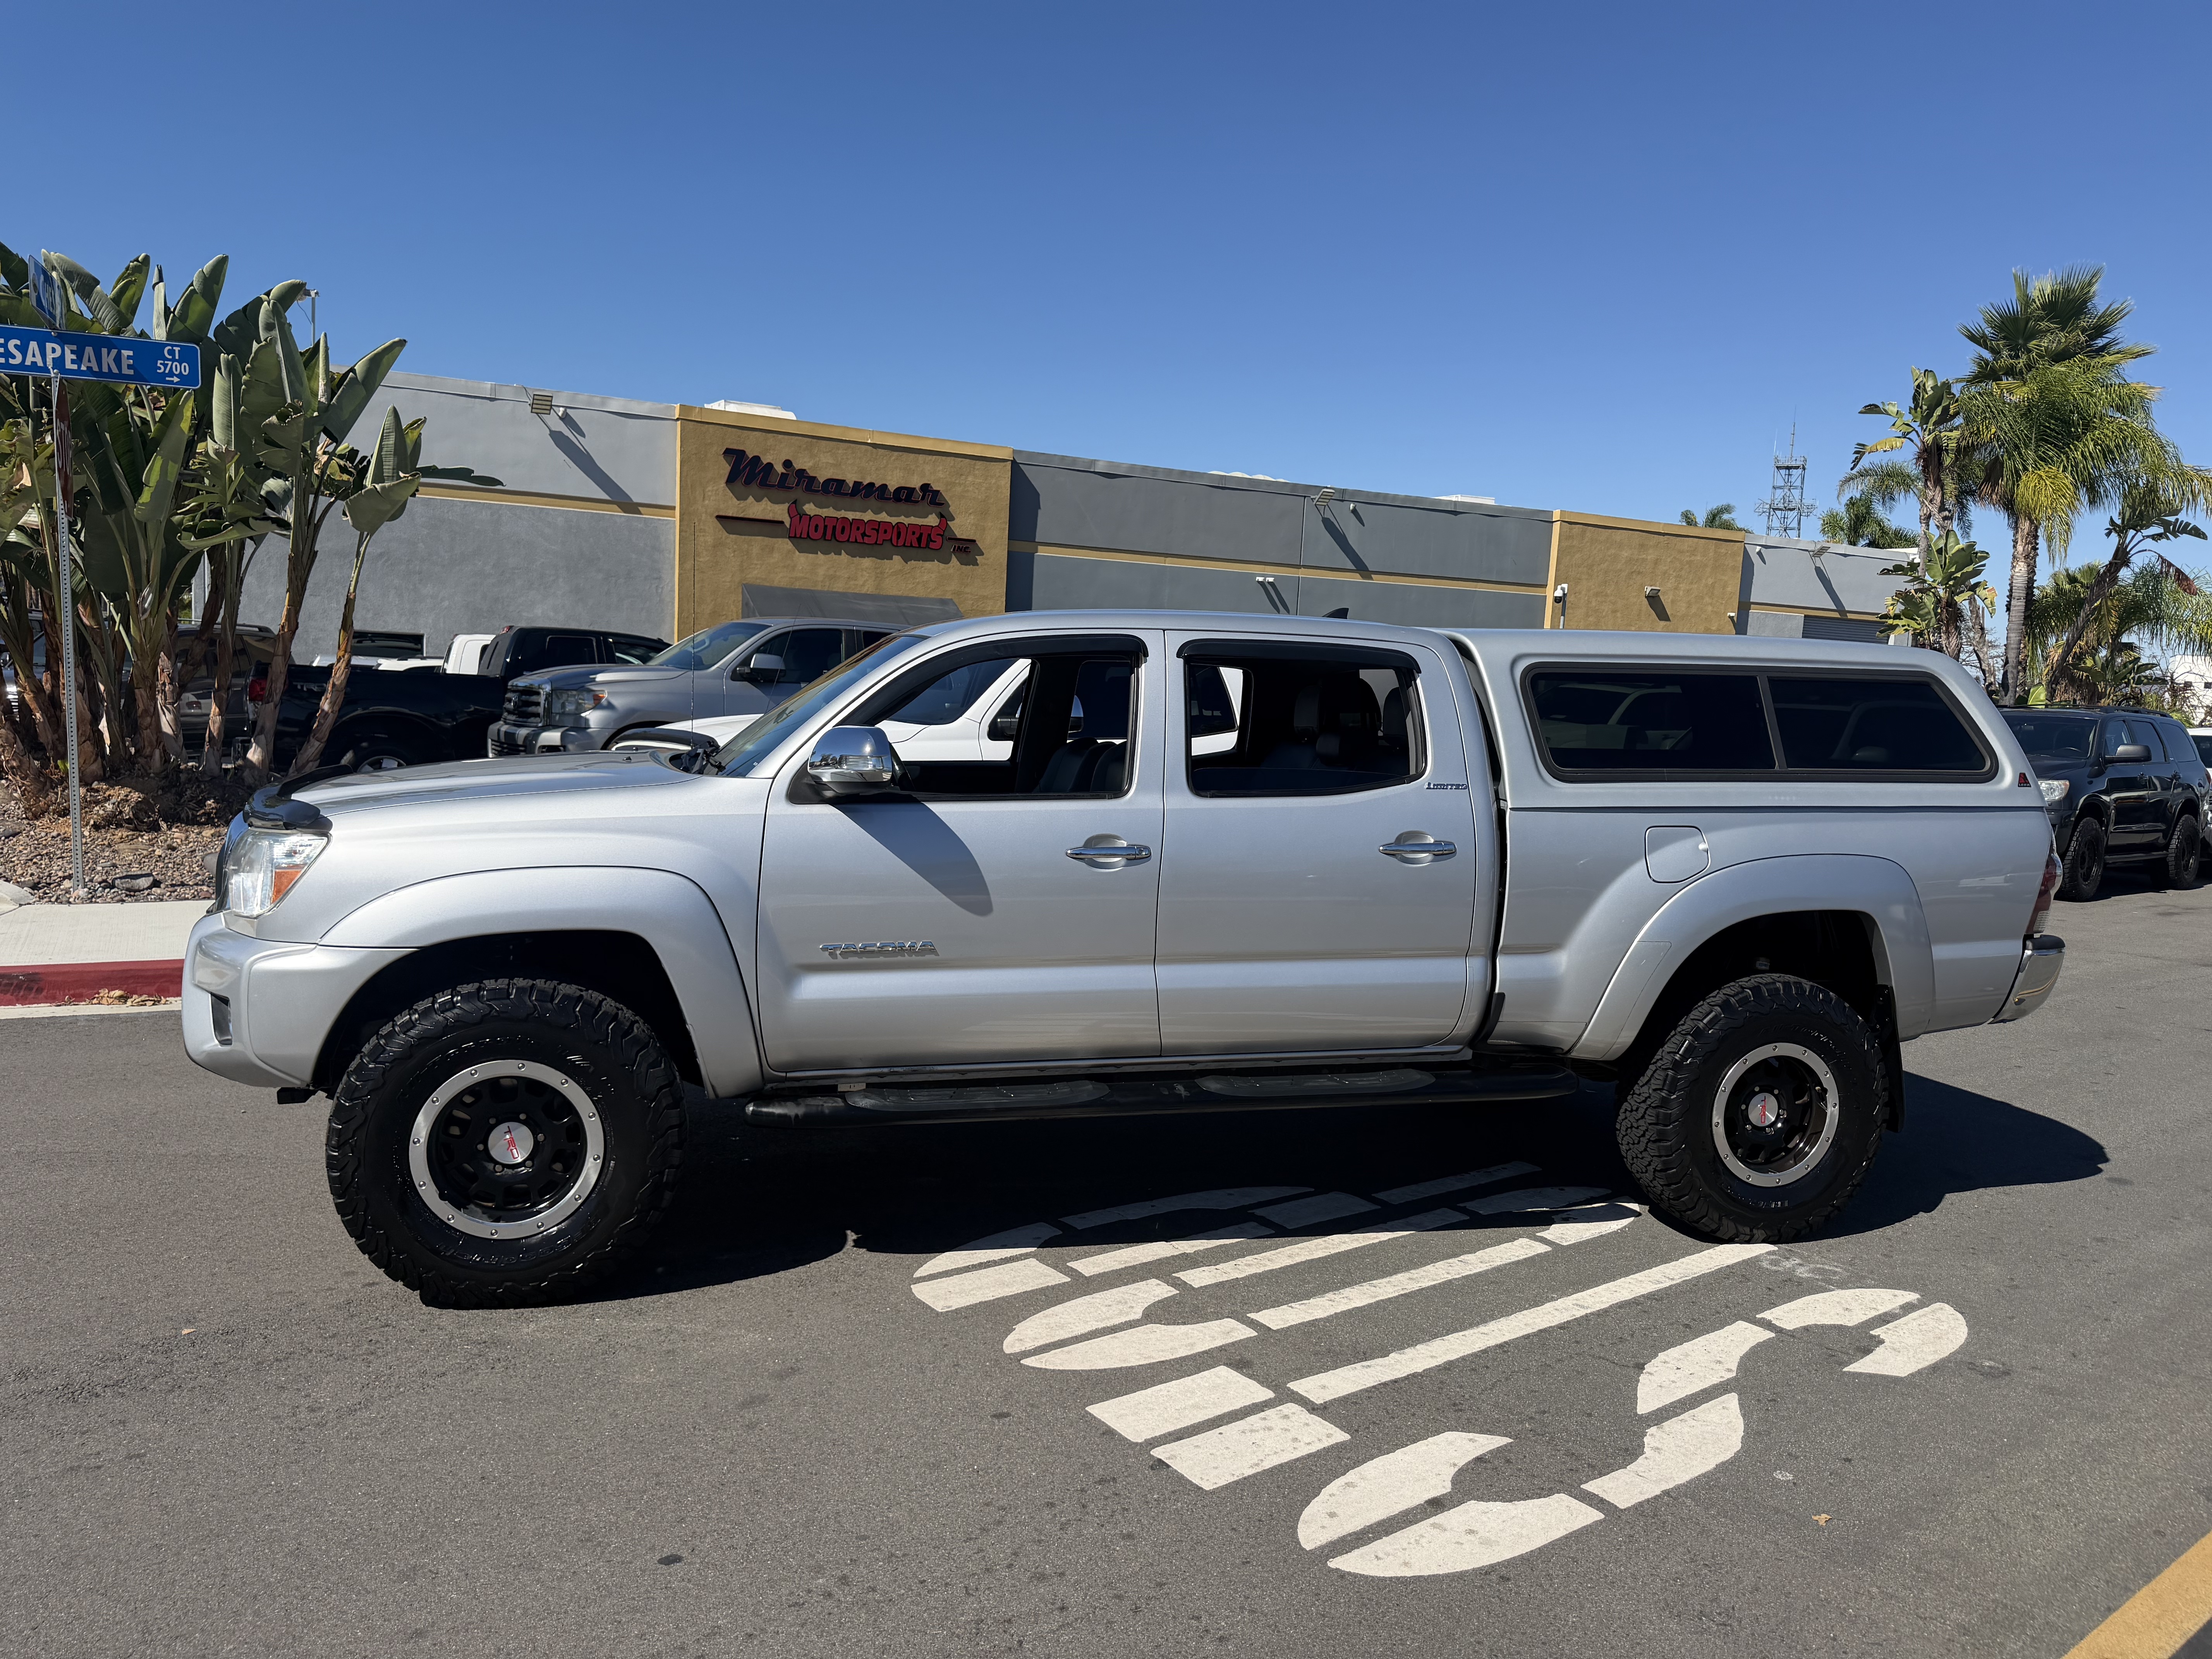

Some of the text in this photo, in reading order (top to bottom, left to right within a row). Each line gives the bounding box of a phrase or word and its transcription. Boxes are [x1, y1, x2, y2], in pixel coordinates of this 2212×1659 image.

[164, 346, 180, 359] CT
[157, 360, 189, 375] 5700
[722, 448, 945, 507] Miramar
[788, 513, 945, 550] MOTORSPORTS
[951, 544, 971, 553] INC.
[819, 941, 936, 955] TACOMA
[503, 1125, 520, 1160] TRD
